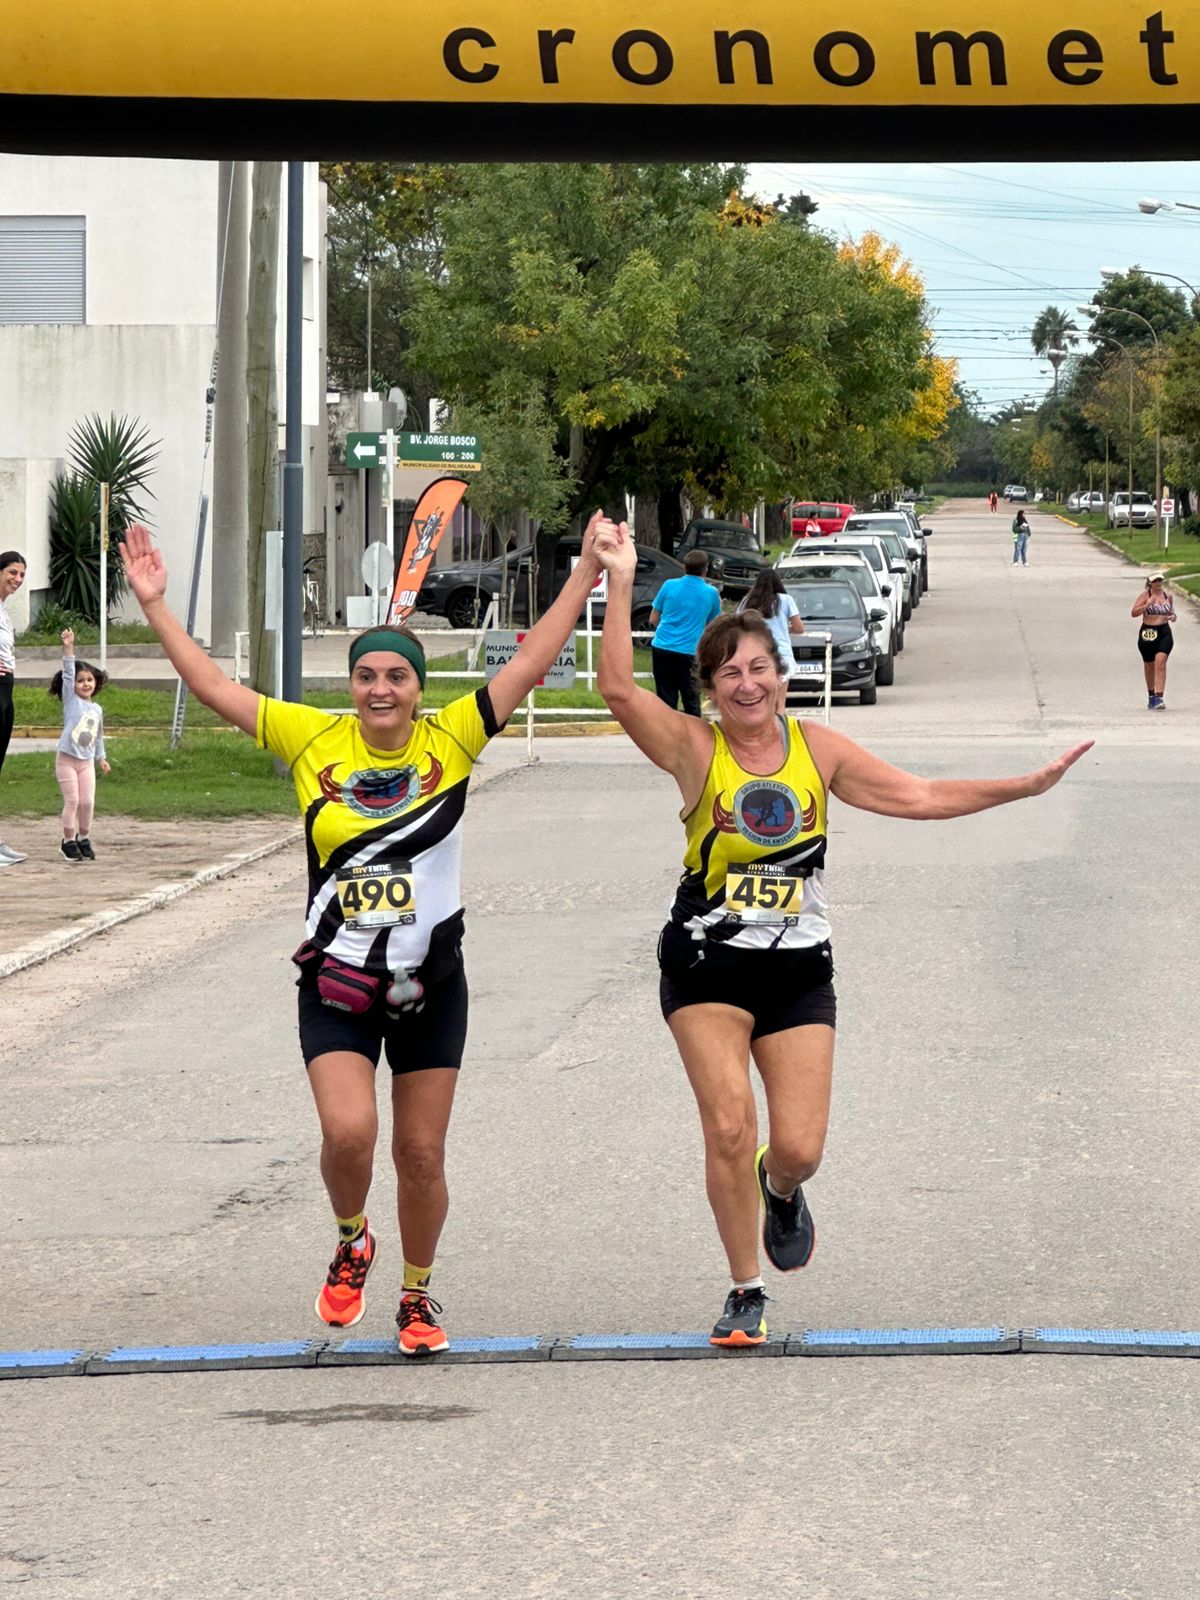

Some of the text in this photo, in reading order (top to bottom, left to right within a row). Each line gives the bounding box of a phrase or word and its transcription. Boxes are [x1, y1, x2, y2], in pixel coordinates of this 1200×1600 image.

[423, 435, 448, 445] JORGE
[450, 435, 476, 446] BOSCO
[441, 452, 455, 460] 100
[461, 452, 475, 460] 200
[342, 876, 411, 912] 490
[732, 877, 797, 909] 457
